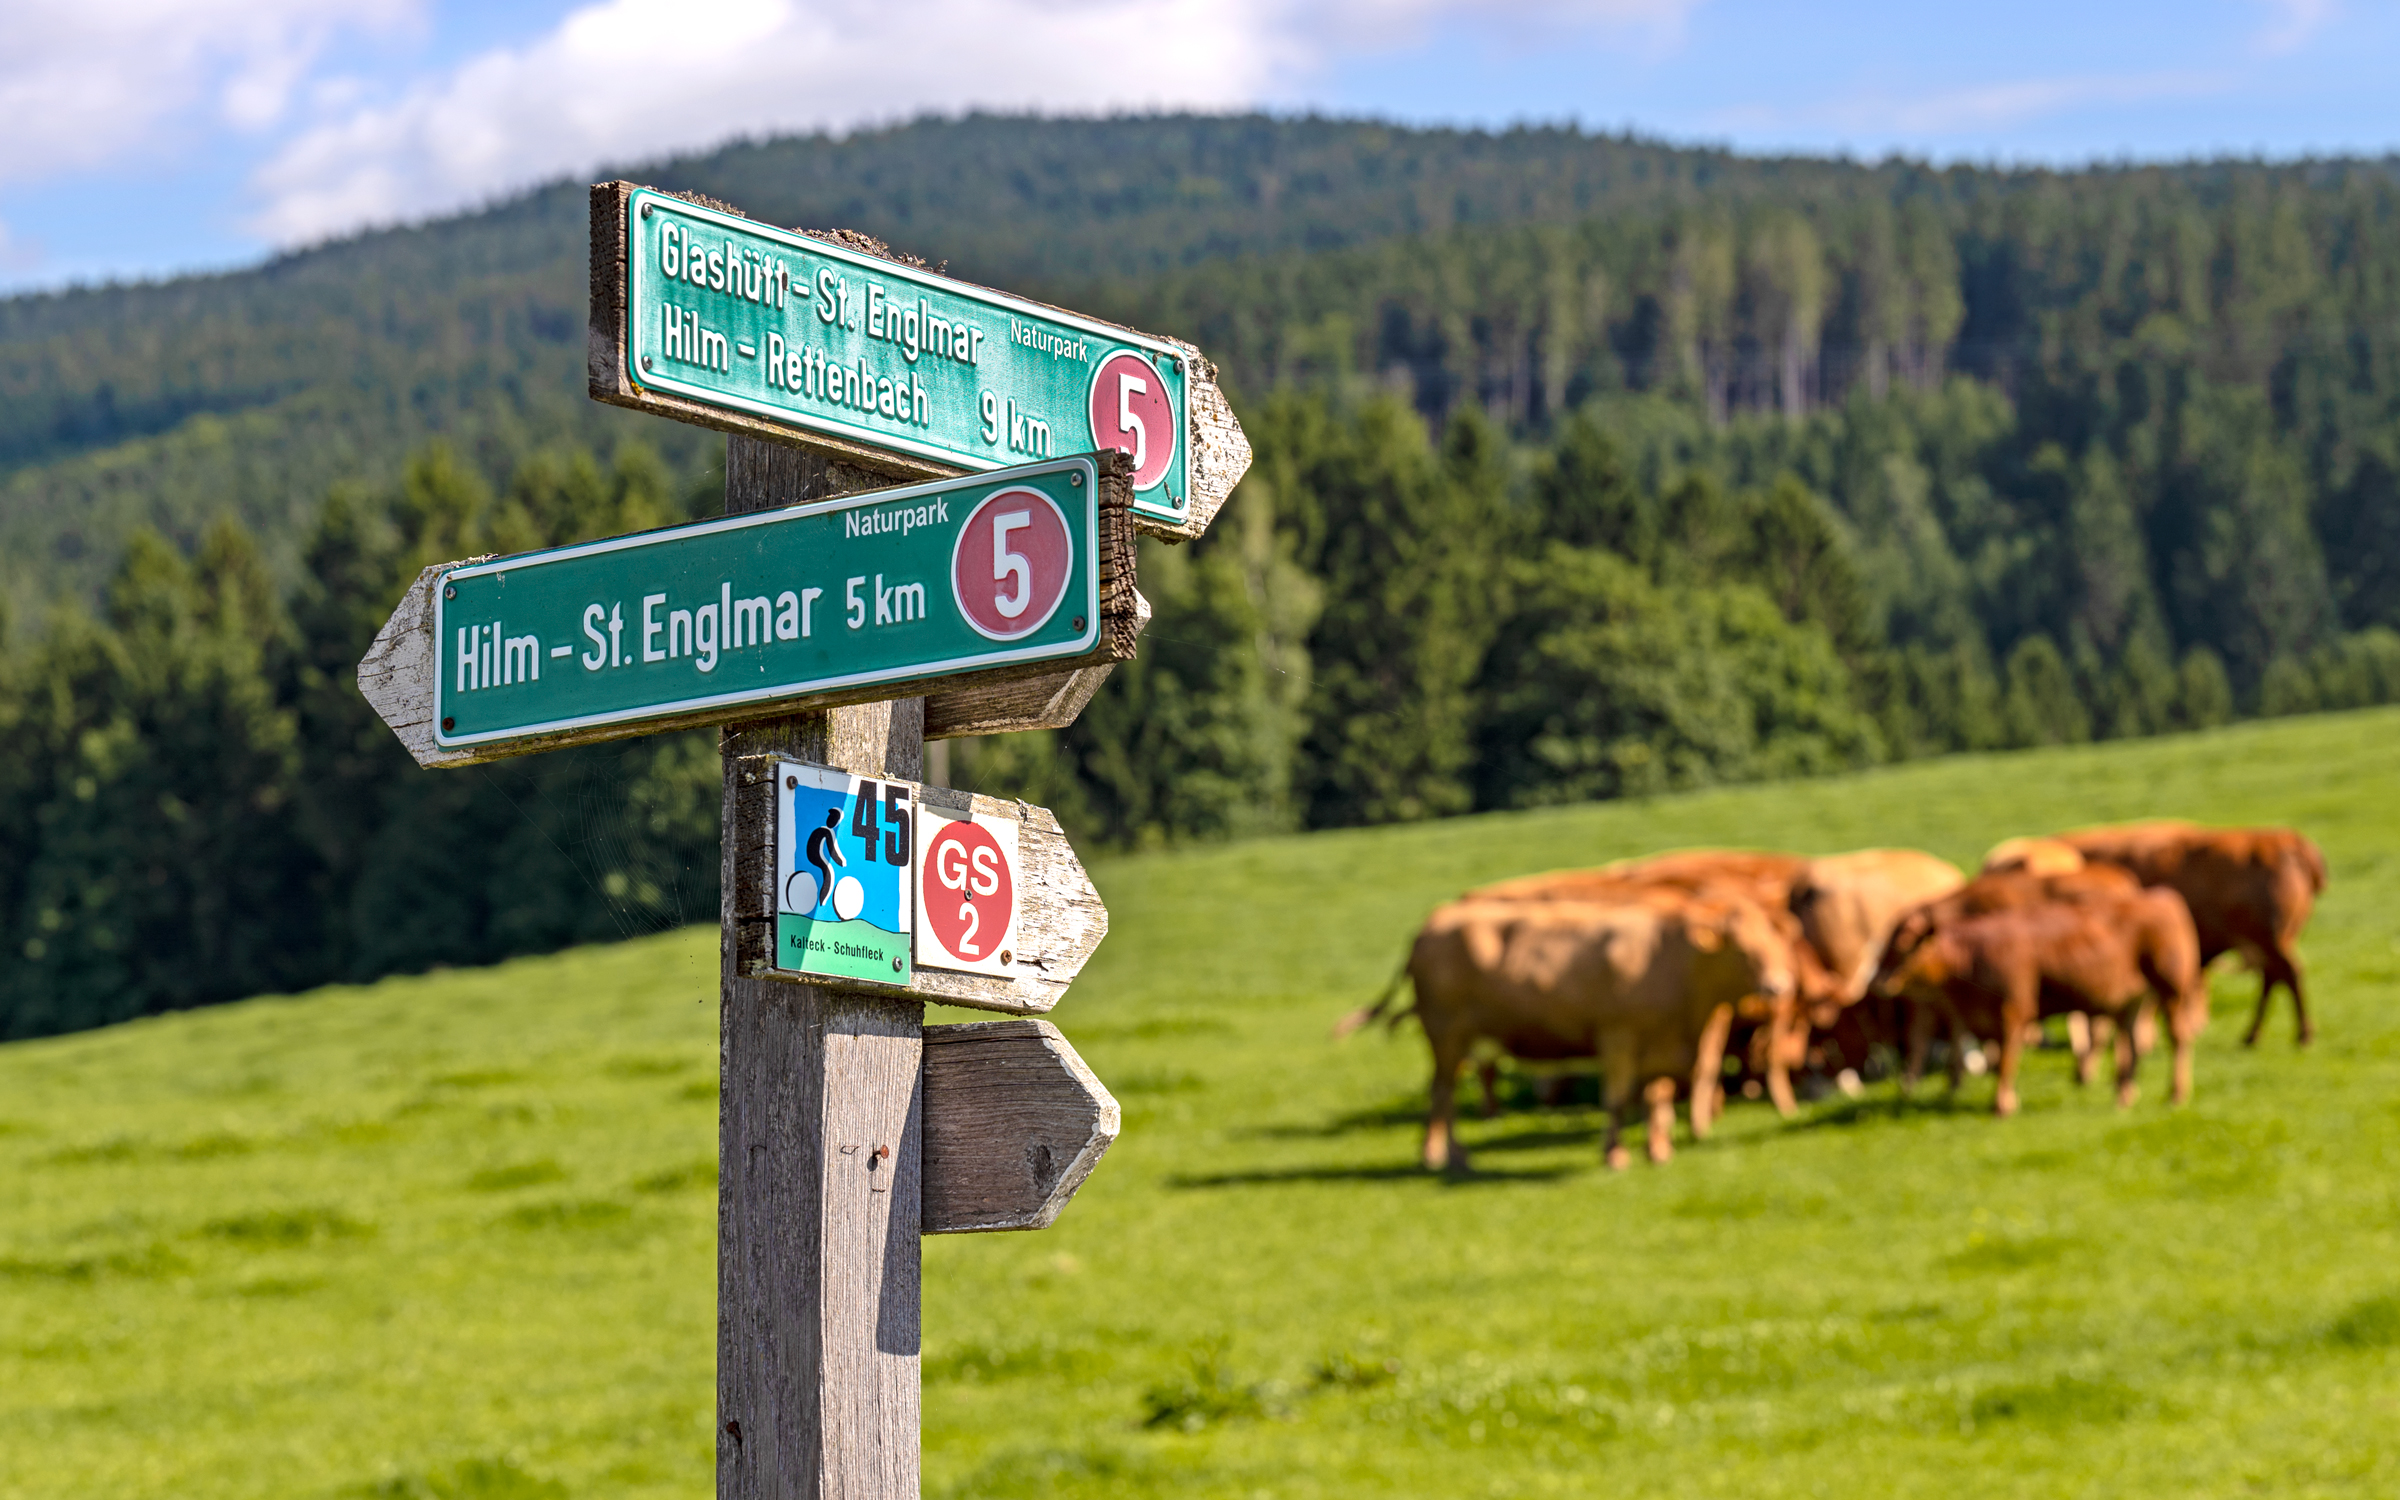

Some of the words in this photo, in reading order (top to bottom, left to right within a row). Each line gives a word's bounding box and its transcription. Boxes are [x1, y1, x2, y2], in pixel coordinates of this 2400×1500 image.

[661, 221, 787, 309] Glashütt
[816, 267, 855, 330] St.
[866, 282, 984, 364] Englmar
[663, 302, 729, 372] Hilm
[766, 331, 931, 427] Rettenbach
[1010, 318, 1089, 363] Naturpark
[980, 389, 999, 444] 9
[1008, 397, 1052, 457] km
[1119, 372, 1147, 471] 5
[845, 497, 949, 538] Naturpark
[993, 510, 1031, 618] 5
[456, 619, 541, 693] Hilm
[581, 600, 632, 671] St.
[643, 582, 823, 673] Englmar
[846, 575, 867, 630] 5
[874, 573, 926, 625] km
[852, 780, 910, 867] 45
[937, 838, 999, 896] GS
[790, 934, 825, 953] Kalteck
[834, 941, 884, 962] Schuhfleck
[958, 902, 980, 956] 2
